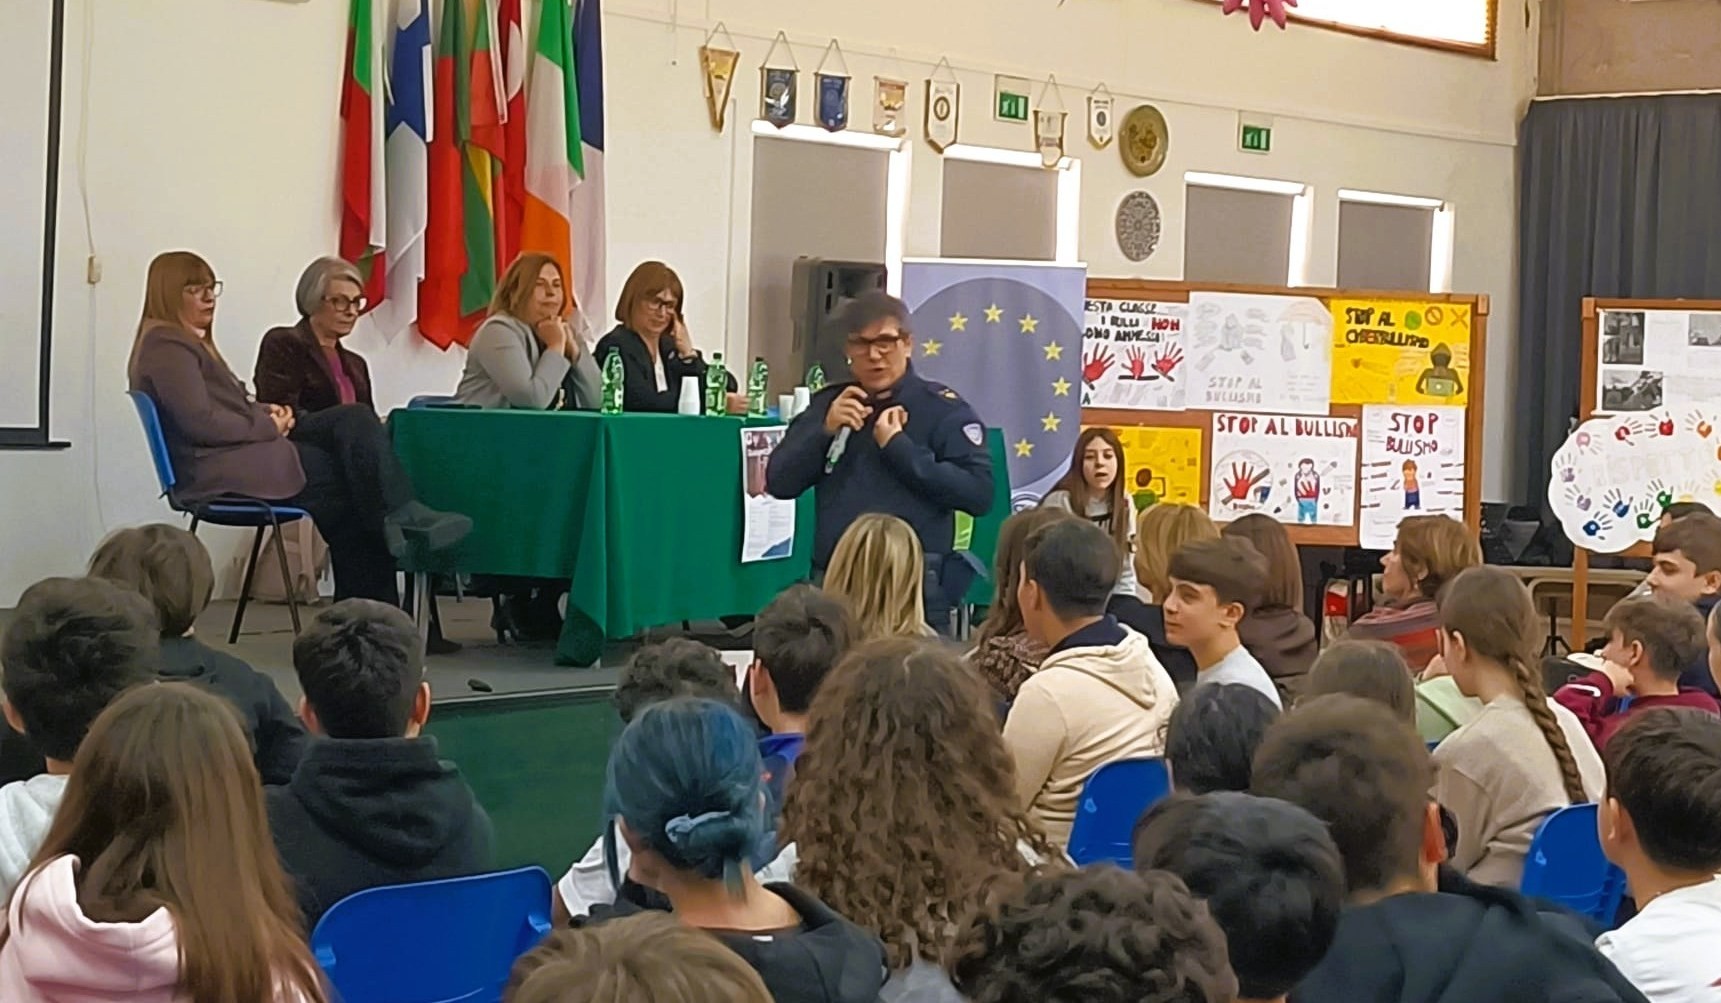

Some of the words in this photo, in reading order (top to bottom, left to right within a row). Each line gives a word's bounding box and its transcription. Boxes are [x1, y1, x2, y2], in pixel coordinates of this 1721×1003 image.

[1377, 311, 1396, 326] AL
[1083, 326, 1110, 339] ONO
[1207, 376, 1243, 389] STOP
[1247, 377, 1262, 389] AL
[1217, 413, 1258, 434] STOP
[1264, 417, 1289, 436] AL
[1387, 412, 1439, 435] STOP
